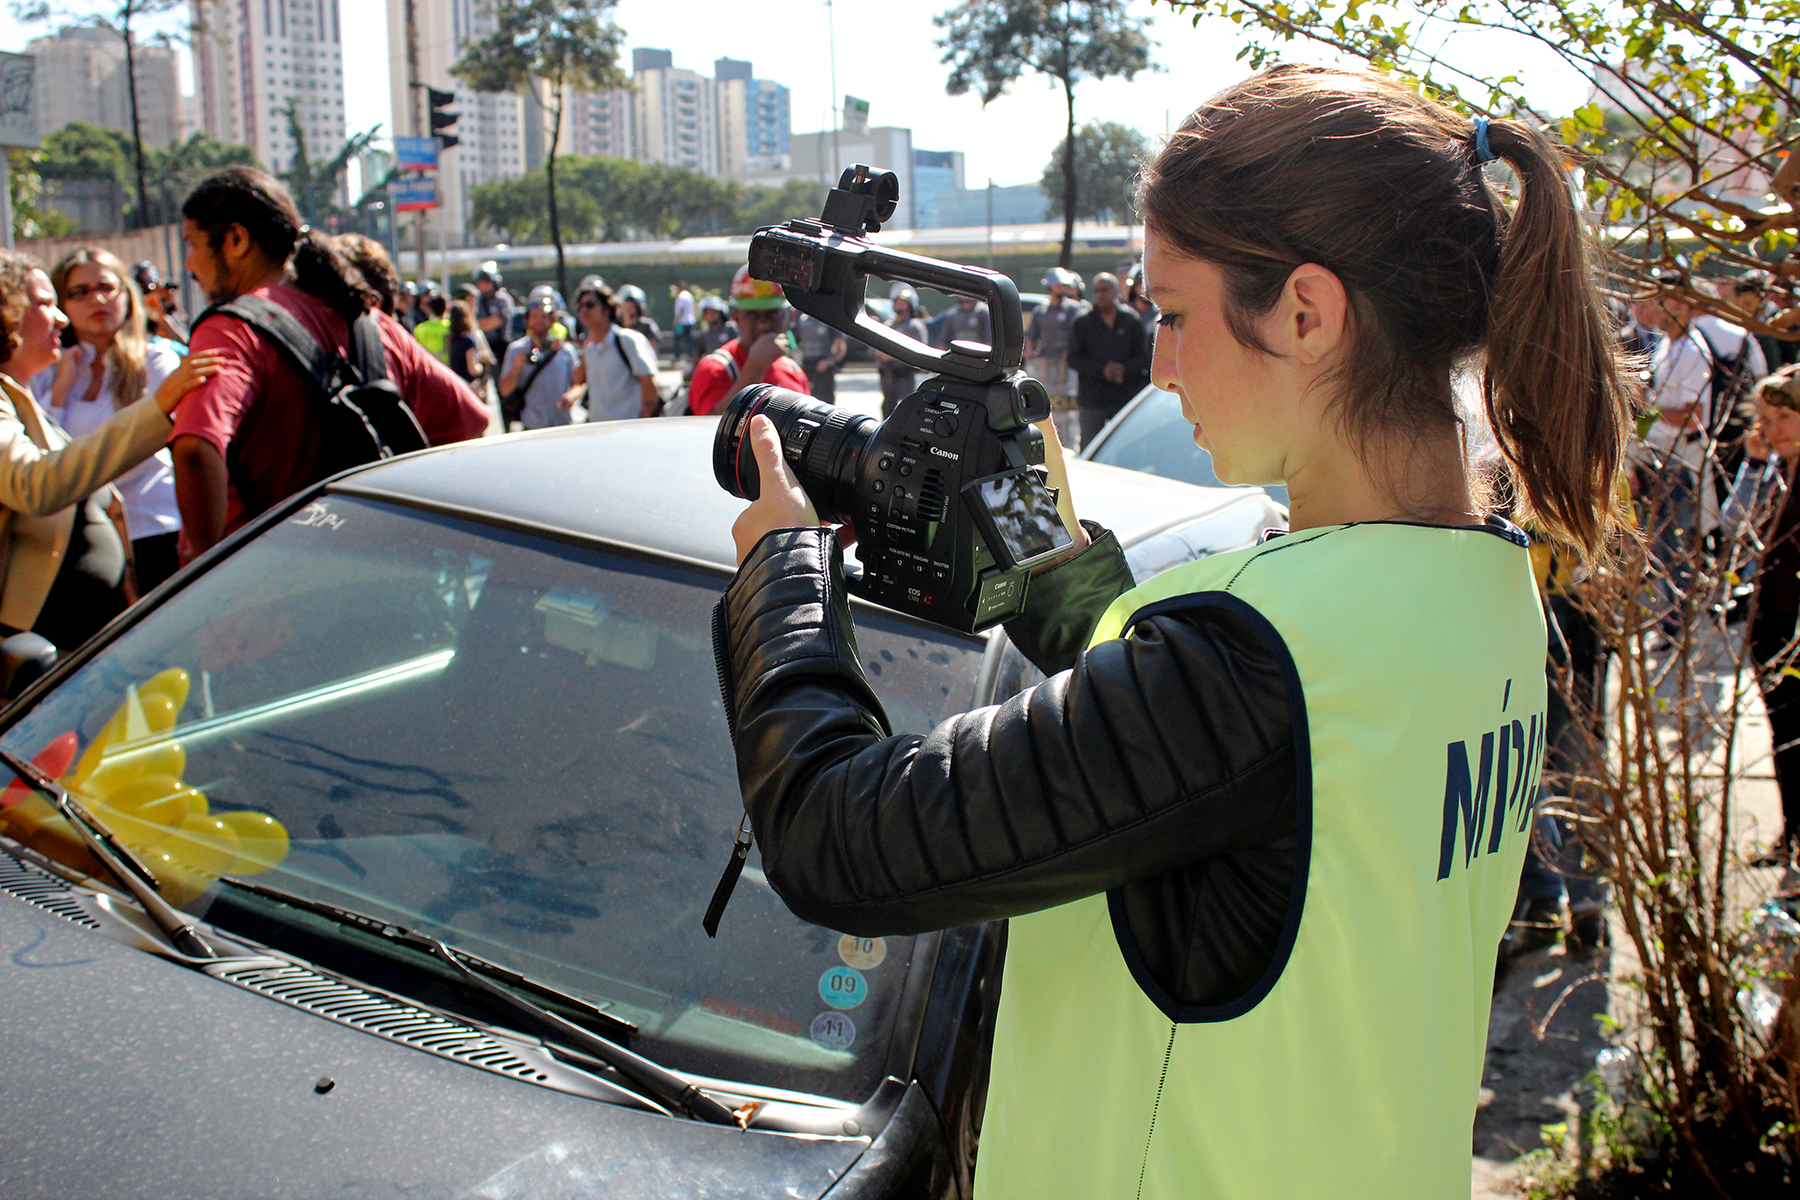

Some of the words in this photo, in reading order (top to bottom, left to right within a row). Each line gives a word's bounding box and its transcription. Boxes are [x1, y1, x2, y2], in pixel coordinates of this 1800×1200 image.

[924, 407, 940, 415] CAMERA
[930, 446, 959, 460] Canon
[886, 522, 902, 531] CUSTOM
[901, 526, 916, 534] PICTURE
[907, 587, 922, 597] EOS
[853, 937, 874, 954] 10
[830, 974, 857, 993] 09
[825, 1019, 844, 1037] 11
